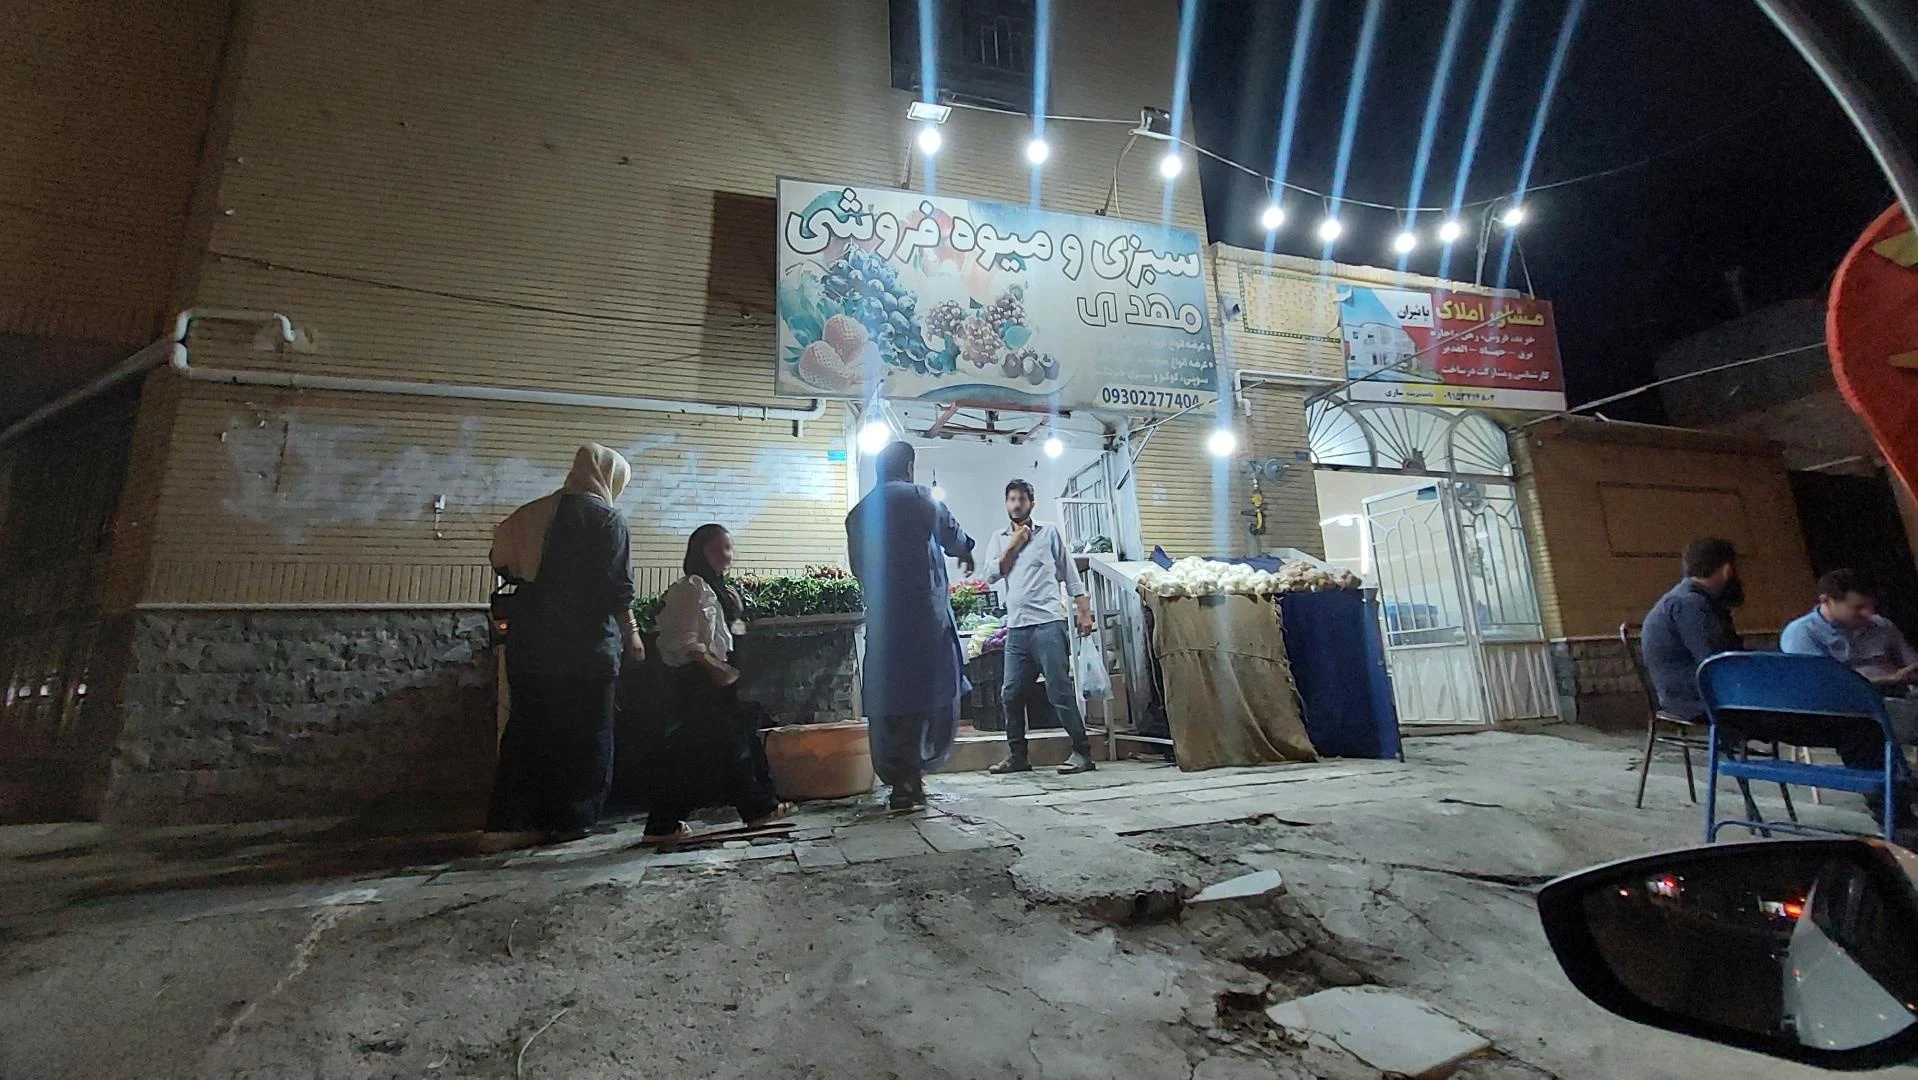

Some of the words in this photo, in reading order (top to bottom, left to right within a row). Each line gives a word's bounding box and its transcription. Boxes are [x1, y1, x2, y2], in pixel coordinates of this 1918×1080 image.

[785, 187, 941, 264] فروشی
[950, 216, 1054, 273] میوه
[1061, 234, 1083, 281] و
[1091, 234, 1200, 288] سبزی
[1077, 292, 1204, 334] مهدی
[1436, 301, 1485, 322] املاک
[1489, 304, 1545, 328] مشاور
[1102, 387, 1200, 409] 09302277404
